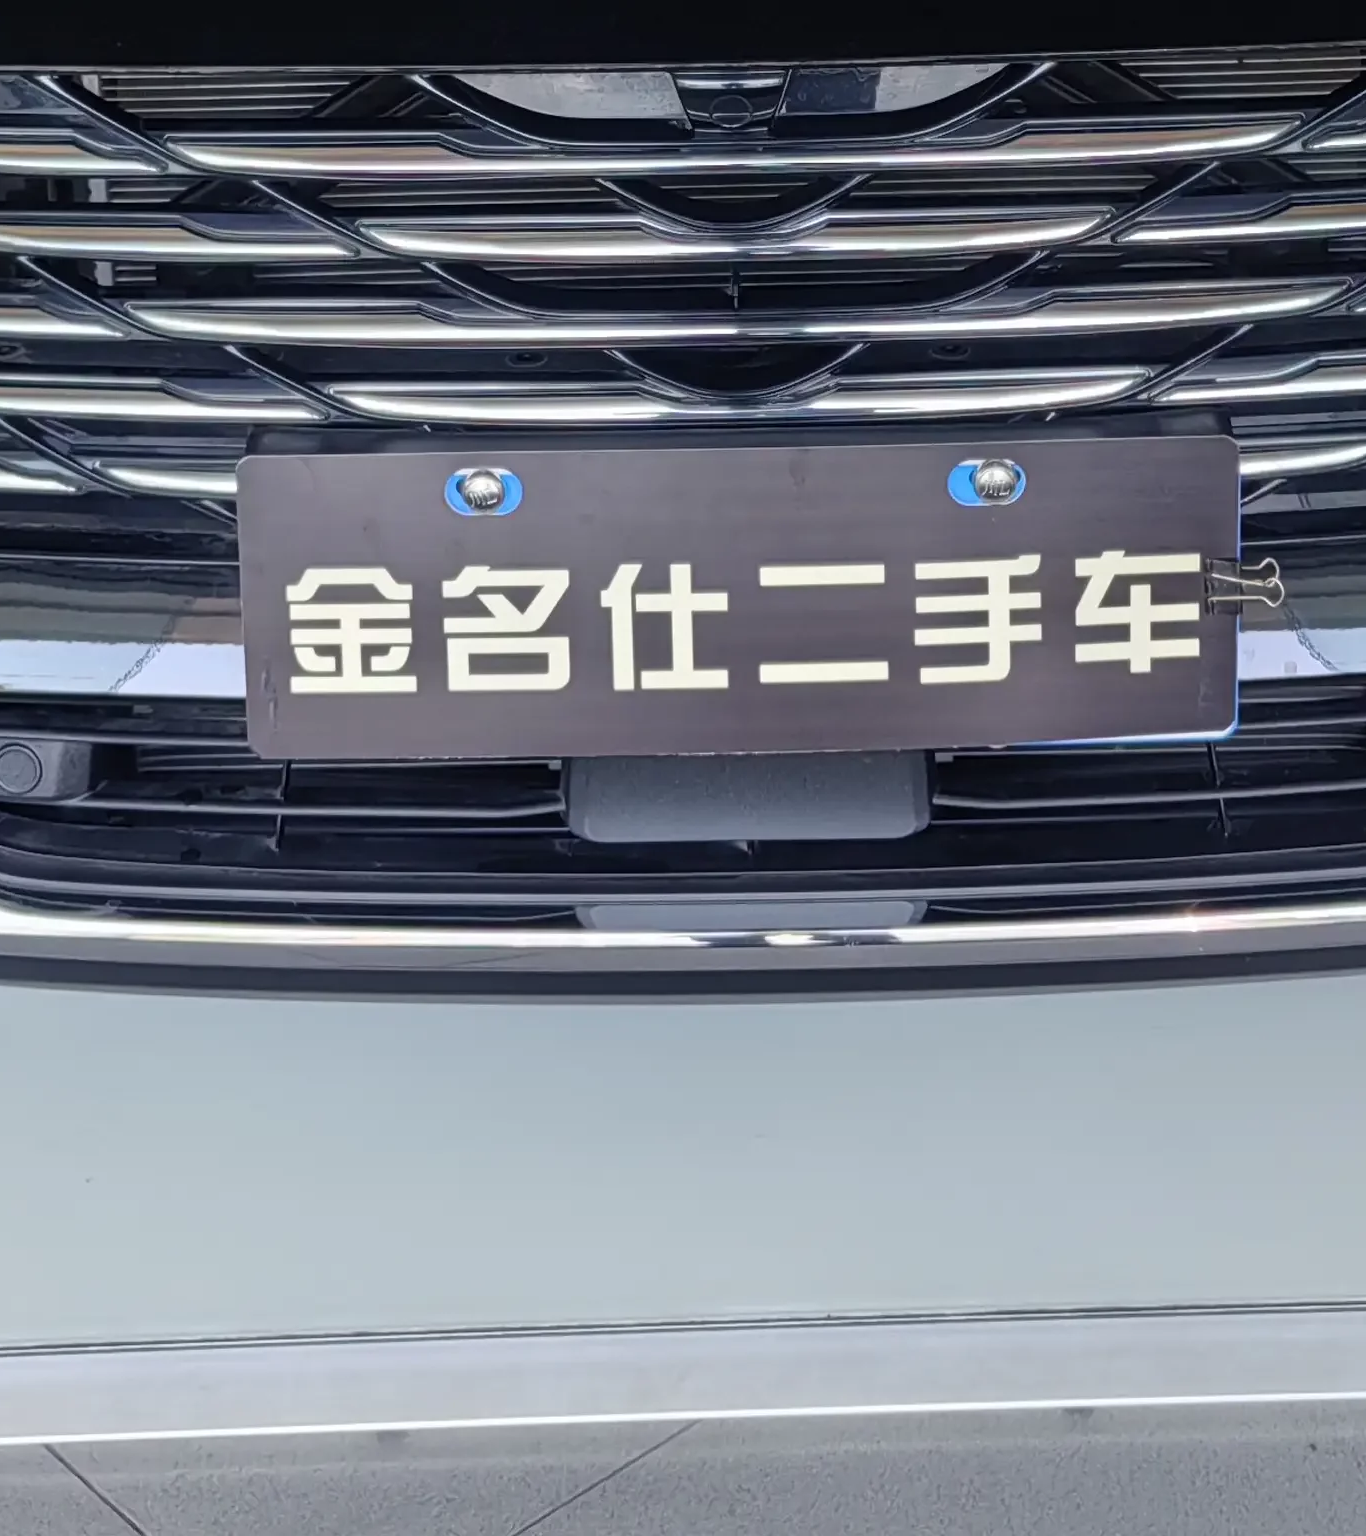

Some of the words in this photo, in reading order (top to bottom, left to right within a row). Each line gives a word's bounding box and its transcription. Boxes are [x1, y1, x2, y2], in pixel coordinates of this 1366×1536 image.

[285, 550, 1202, 696] 金名仕二手车
